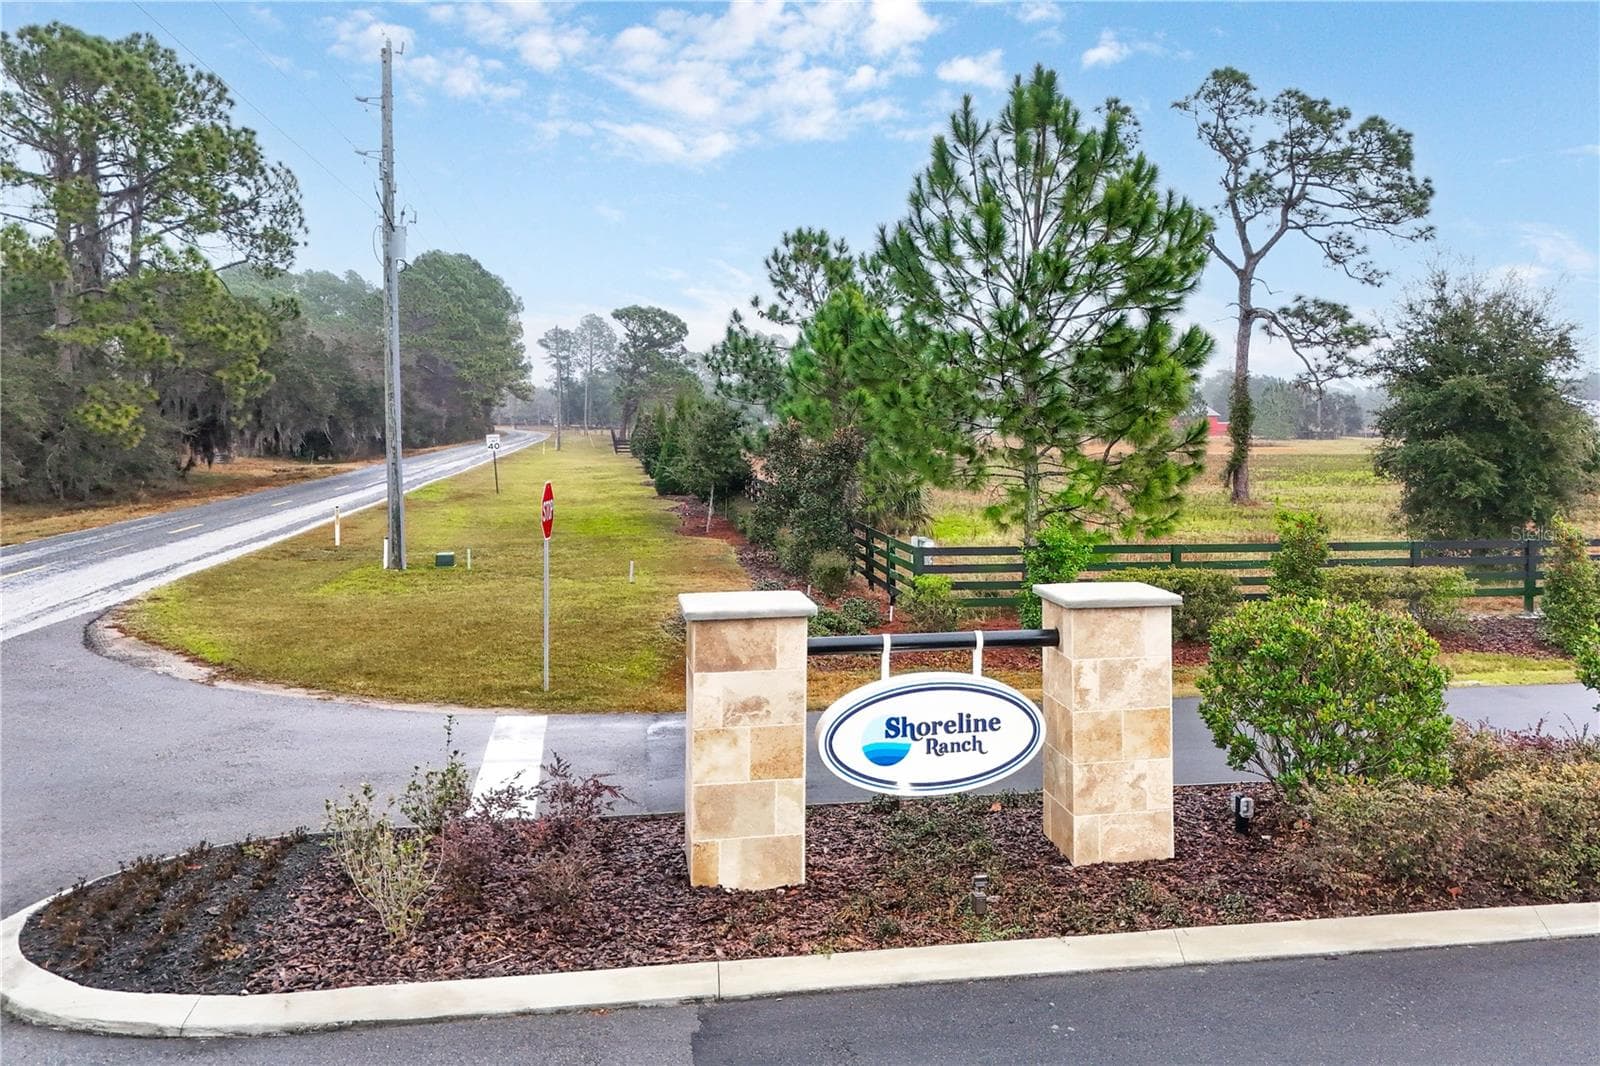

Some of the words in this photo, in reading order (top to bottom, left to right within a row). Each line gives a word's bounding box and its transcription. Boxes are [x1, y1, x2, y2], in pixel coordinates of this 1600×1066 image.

[542, 500, 553, 522] STOP
[884, 712, 1001, 742] Shoreline
[926, 735, 988, 756] Ranch
